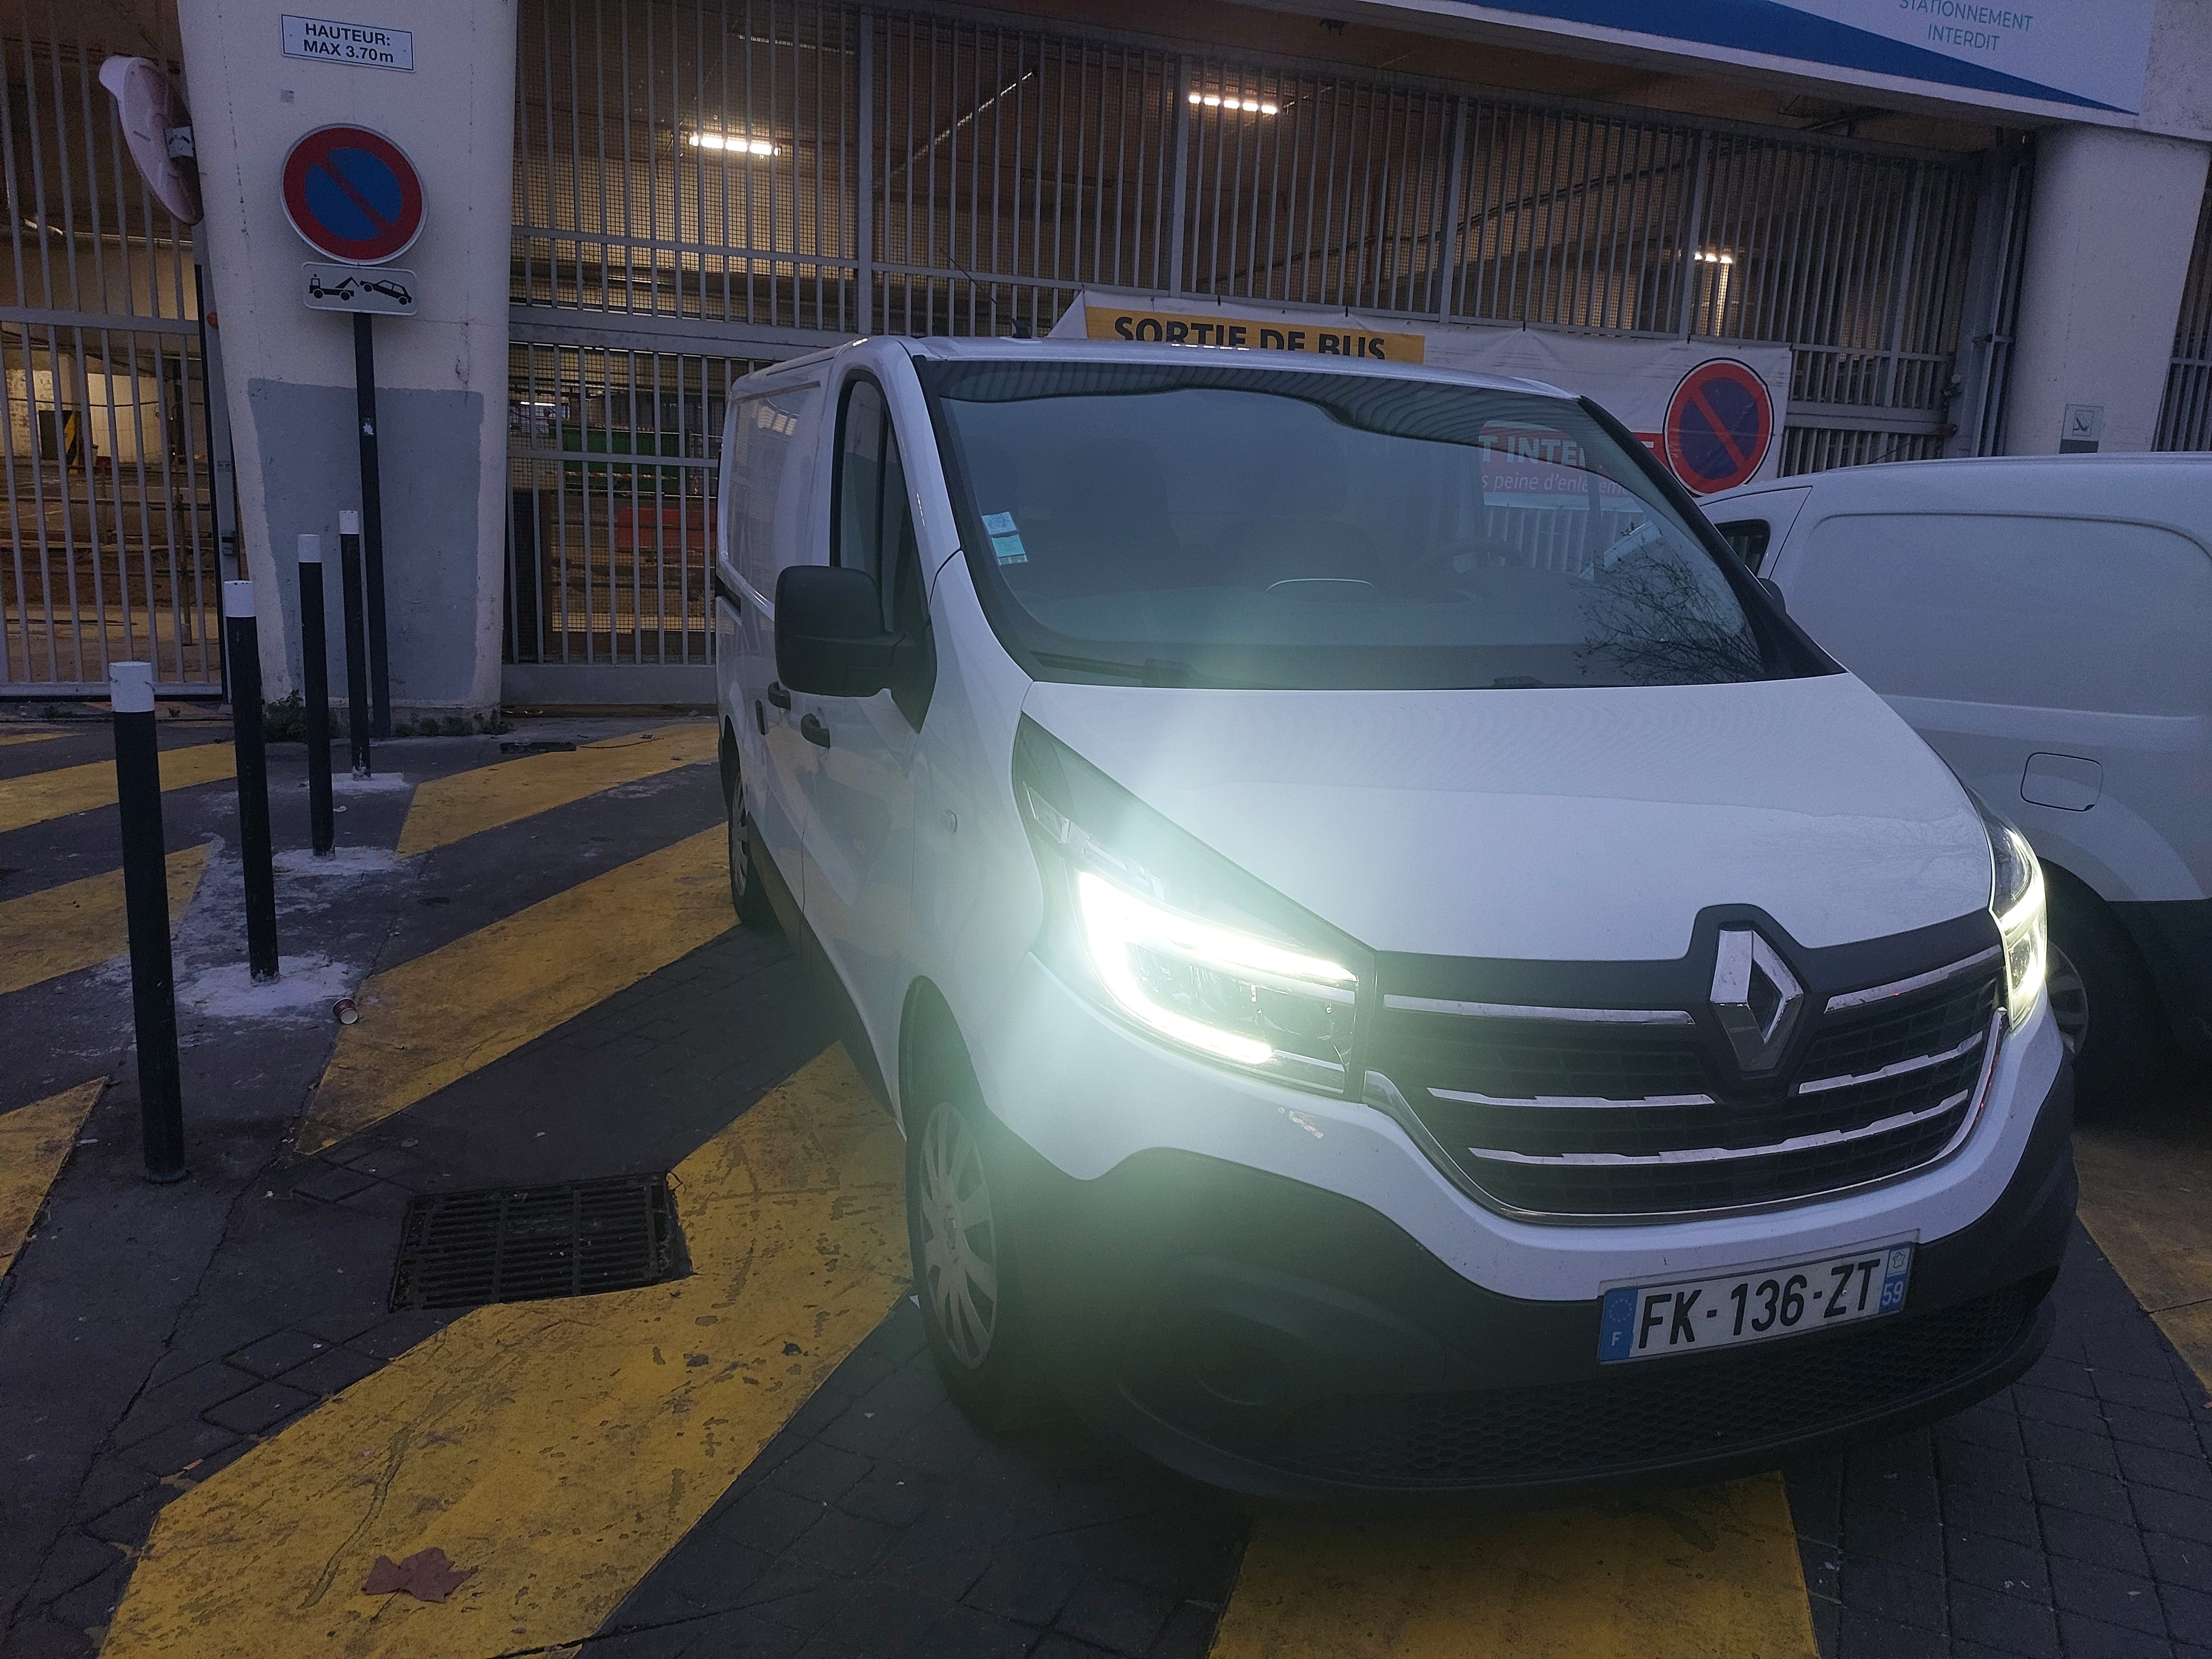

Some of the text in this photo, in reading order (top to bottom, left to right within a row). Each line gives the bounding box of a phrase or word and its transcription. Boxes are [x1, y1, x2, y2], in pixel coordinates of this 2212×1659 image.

[305, 23, 390, 46] HAUTEUR:
[1928, 24, 2000, 51] INTERDIT
[304, 39, 342, 56] MAX
[1115, 316, 1385, 360] SORTIE DE BUS
[1493, 472, 1538, 491] peine
[1881, 1280, 1903, 1305] 59
[1610, 1331, 1622, 1347] F
